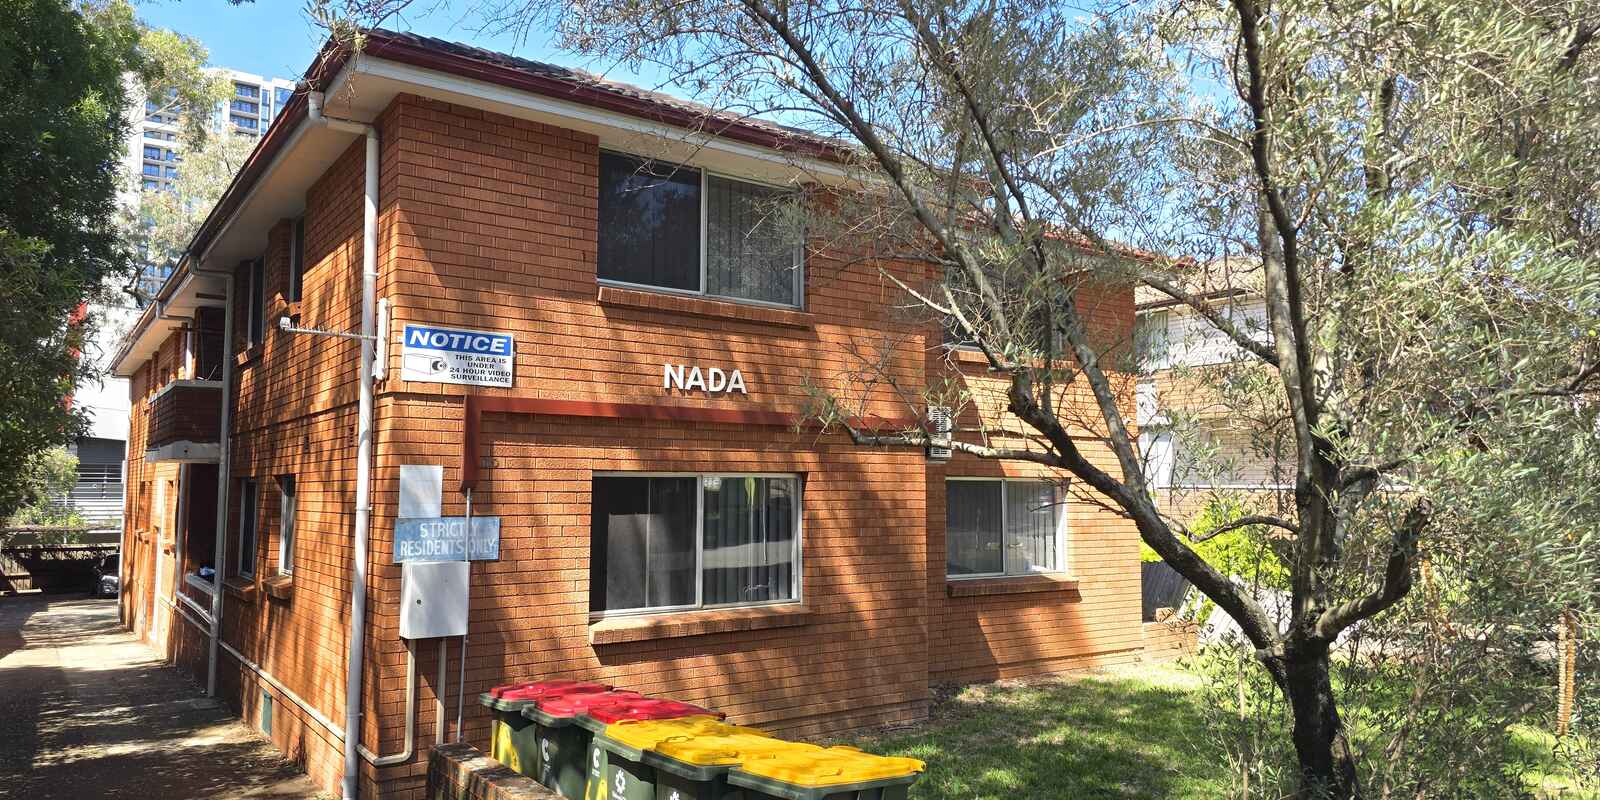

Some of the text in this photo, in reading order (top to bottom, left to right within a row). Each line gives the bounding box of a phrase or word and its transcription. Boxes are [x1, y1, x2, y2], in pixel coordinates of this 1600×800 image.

[410, 330, 507, 353] NOTICE
[450, 374, 511, 383] SURVEILLANCE
[462, 367, 486, 375] HOUR
[664, 363, 748, 394] NADA
[420, 522, 480, 538] STRICTY
[400, 538, 496, 556] RESIDENTS ONLY
